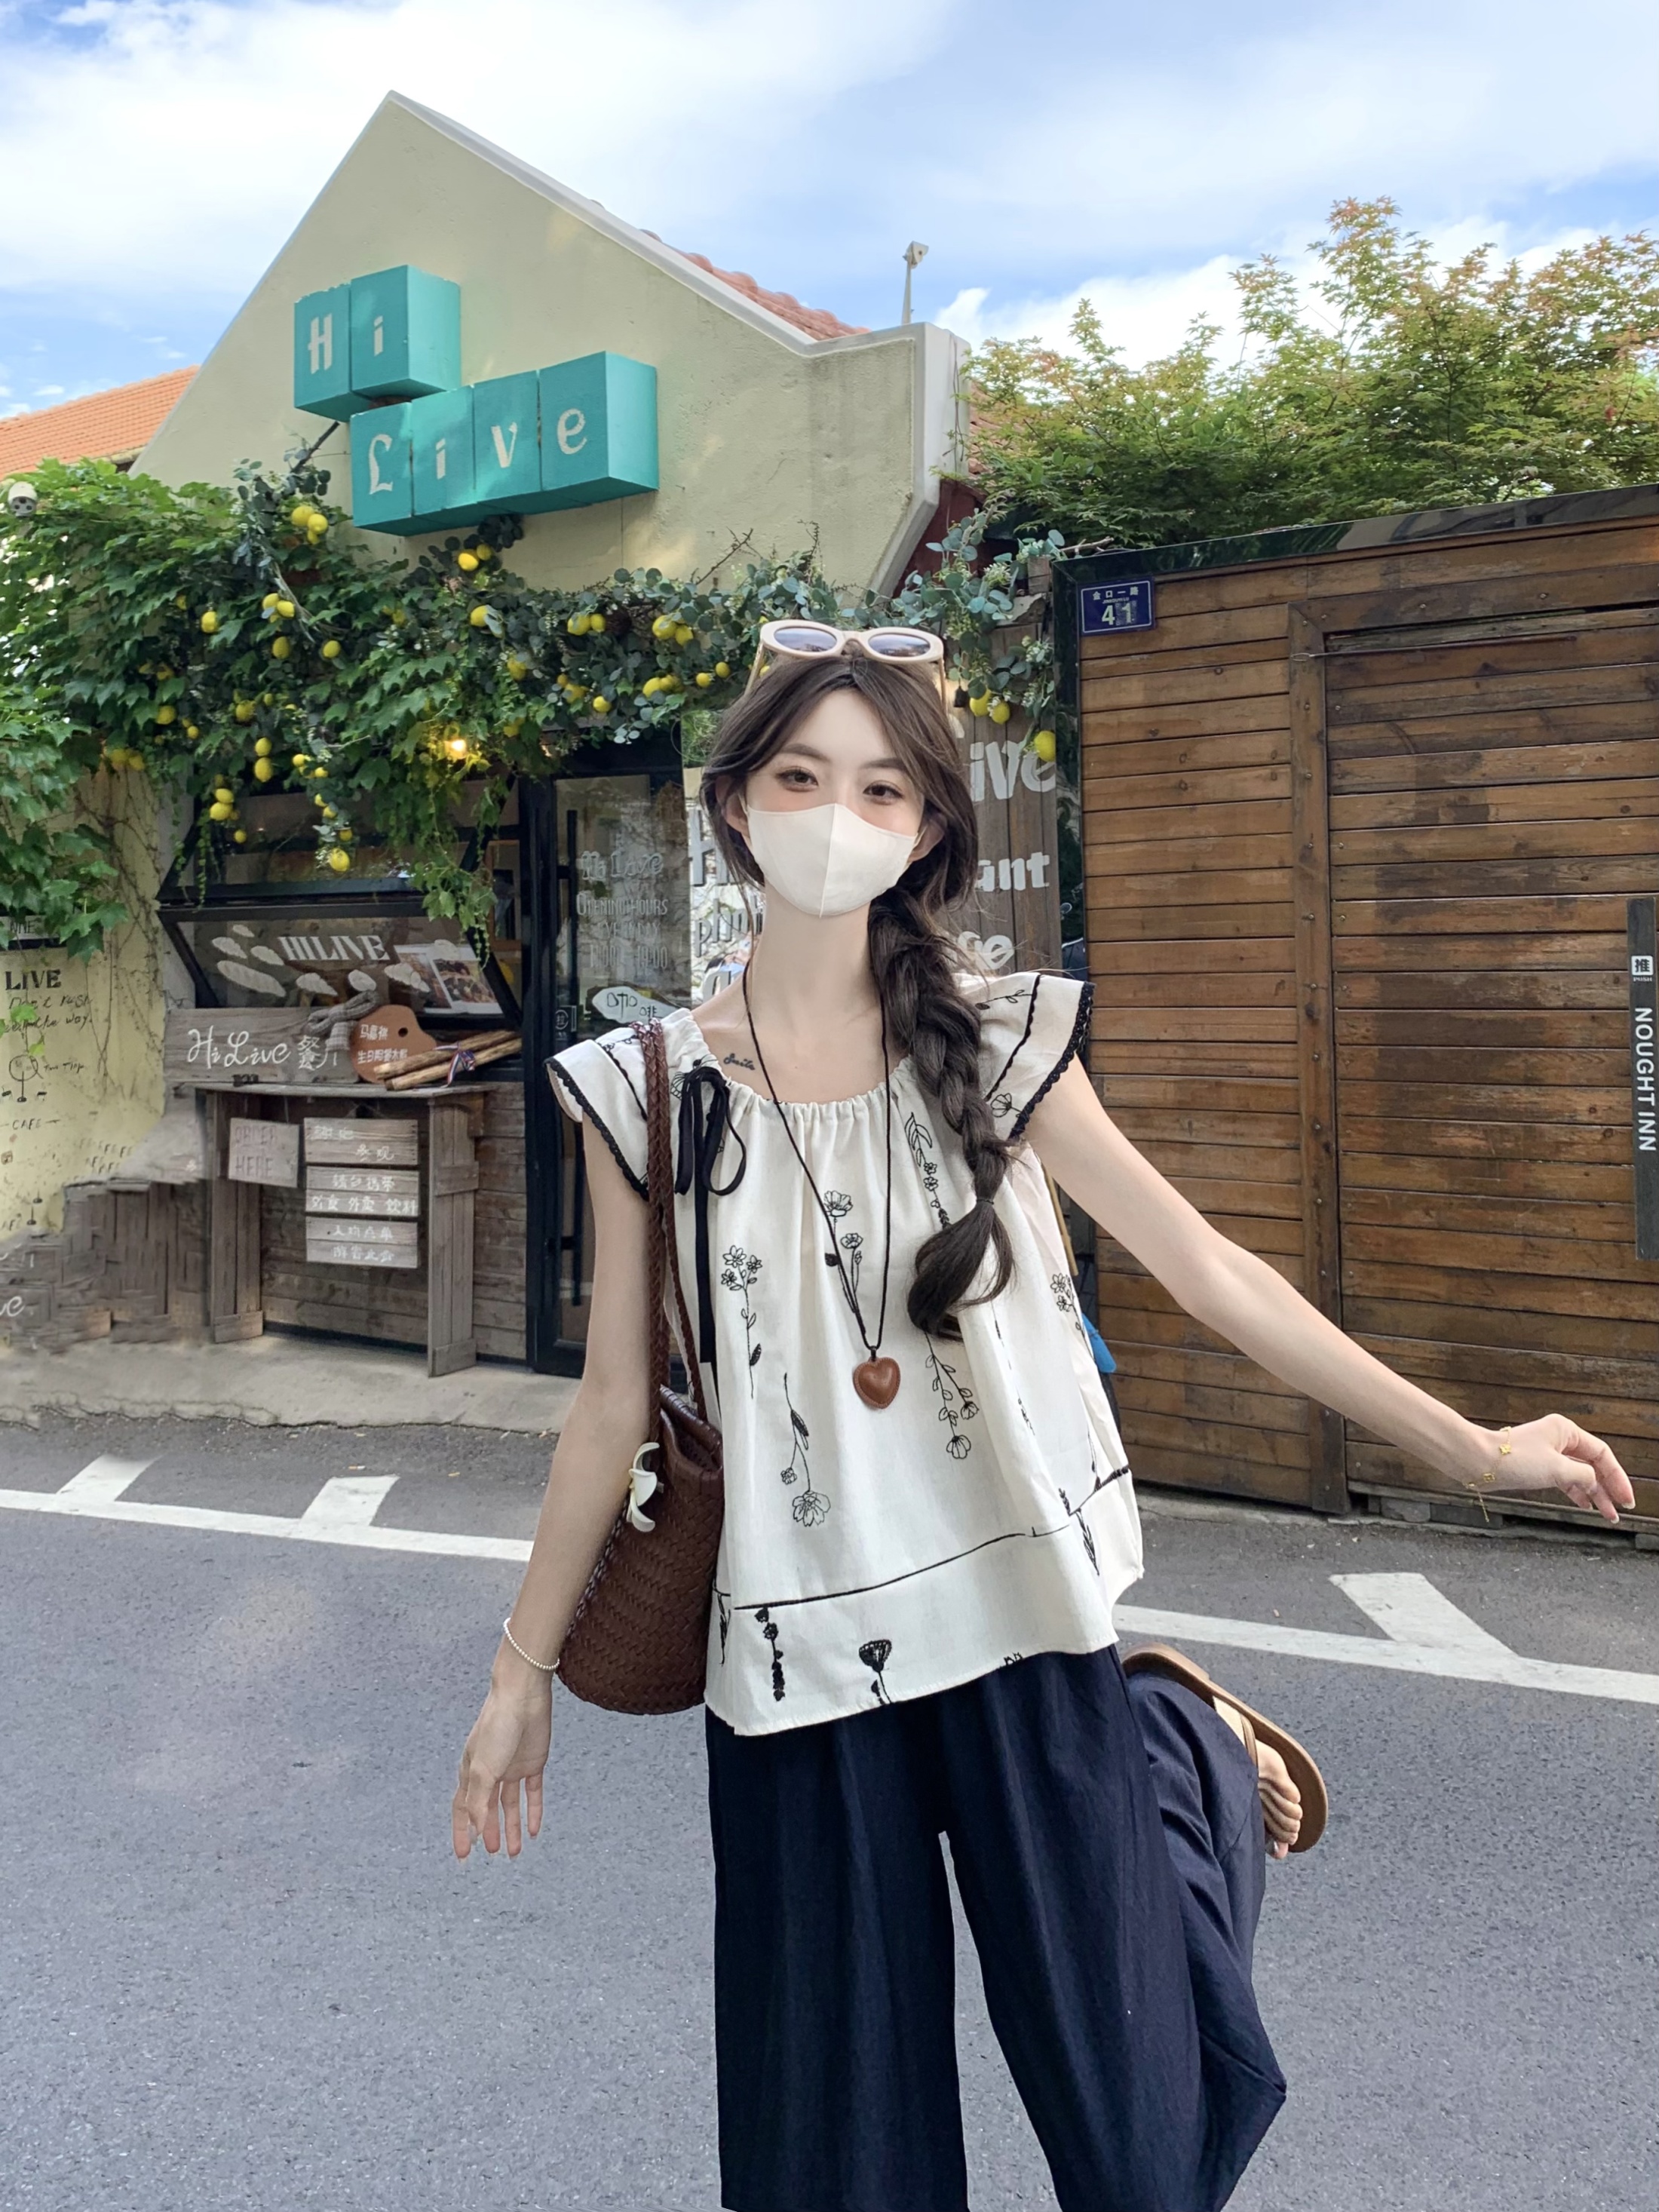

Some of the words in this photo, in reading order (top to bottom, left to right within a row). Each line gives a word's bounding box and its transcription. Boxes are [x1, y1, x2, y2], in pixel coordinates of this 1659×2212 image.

[308, 313, 385, 375] Hi
[368, 408, 588, 495] Live
[1093, 586, 1139, 600] 金口一路
[1102, 603, 1132, 625] 41
[278, 935, 390, 961] HILIVE
[1634, 959, 1650, 973] 推
[5, 968, 62, 991] LIVE
[1635, 1008, 1655, 1106] NOUGHT
[1639, 1112, 1656, 1151] INN
